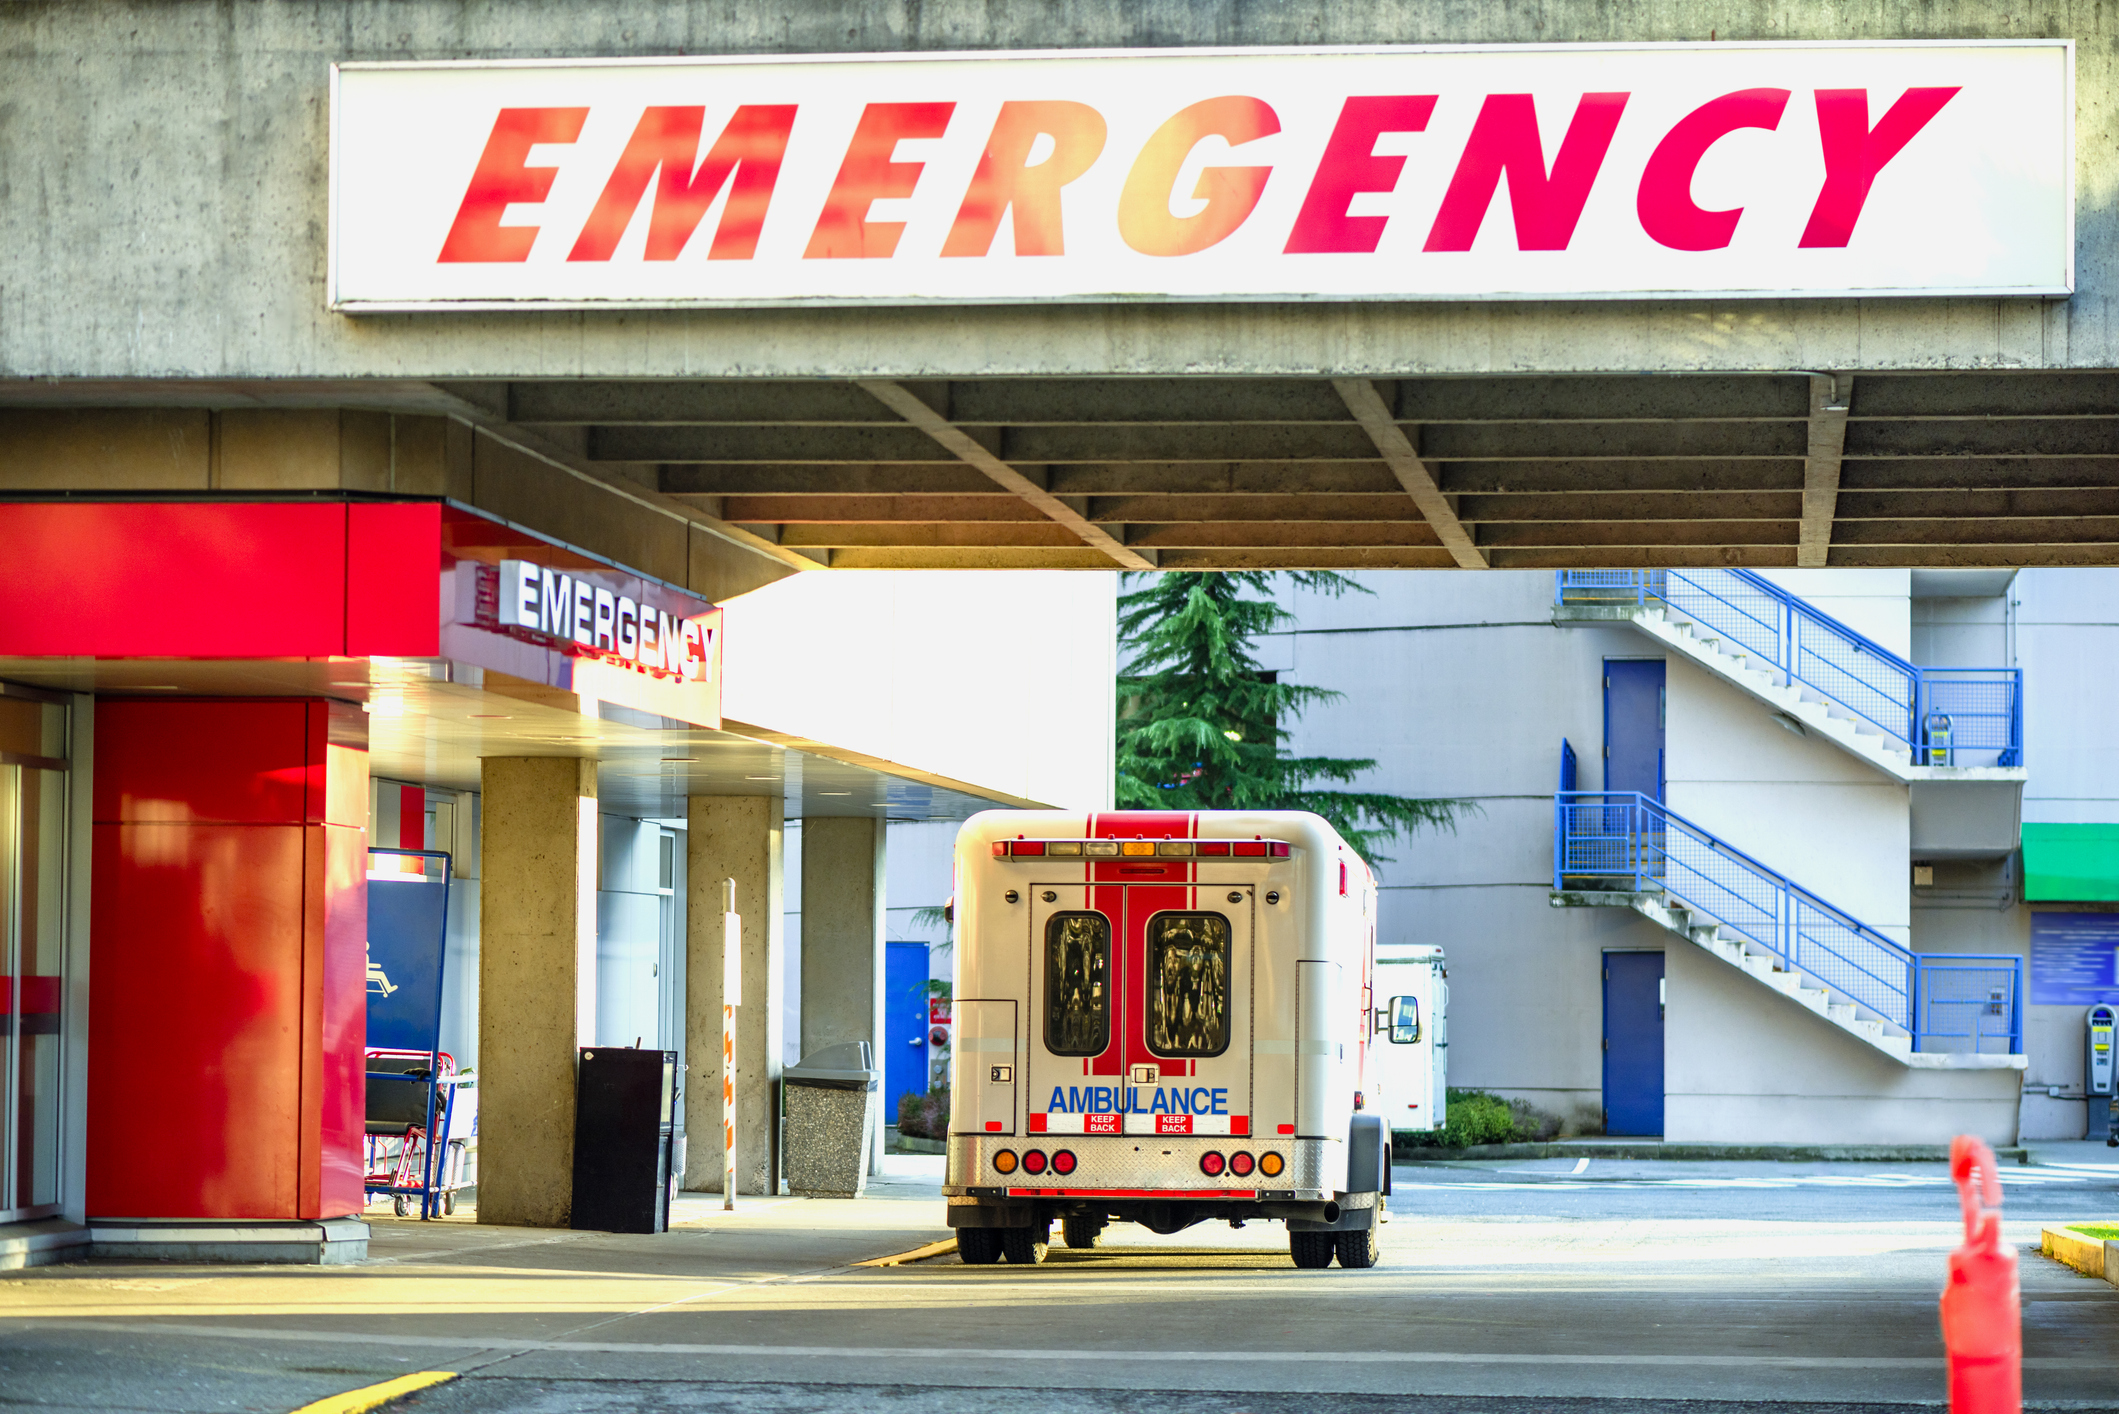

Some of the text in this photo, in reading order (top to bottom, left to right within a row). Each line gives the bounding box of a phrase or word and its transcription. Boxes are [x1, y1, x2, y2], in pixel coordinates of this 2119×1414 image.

[436, 86, 1963, 264] EMERGENCY
[516, 559, 720, 683] EMERGENCY
[1047, 1086, 1228, 1116] AMBULANCE
[1090, 1115, 1115, 1124] KEEP
[1162, 1115, 1187, 1124] KEEP
[1090, 1124, 1115, 1133] BACK
[1161, 1124, 1187, 1133] BACK
